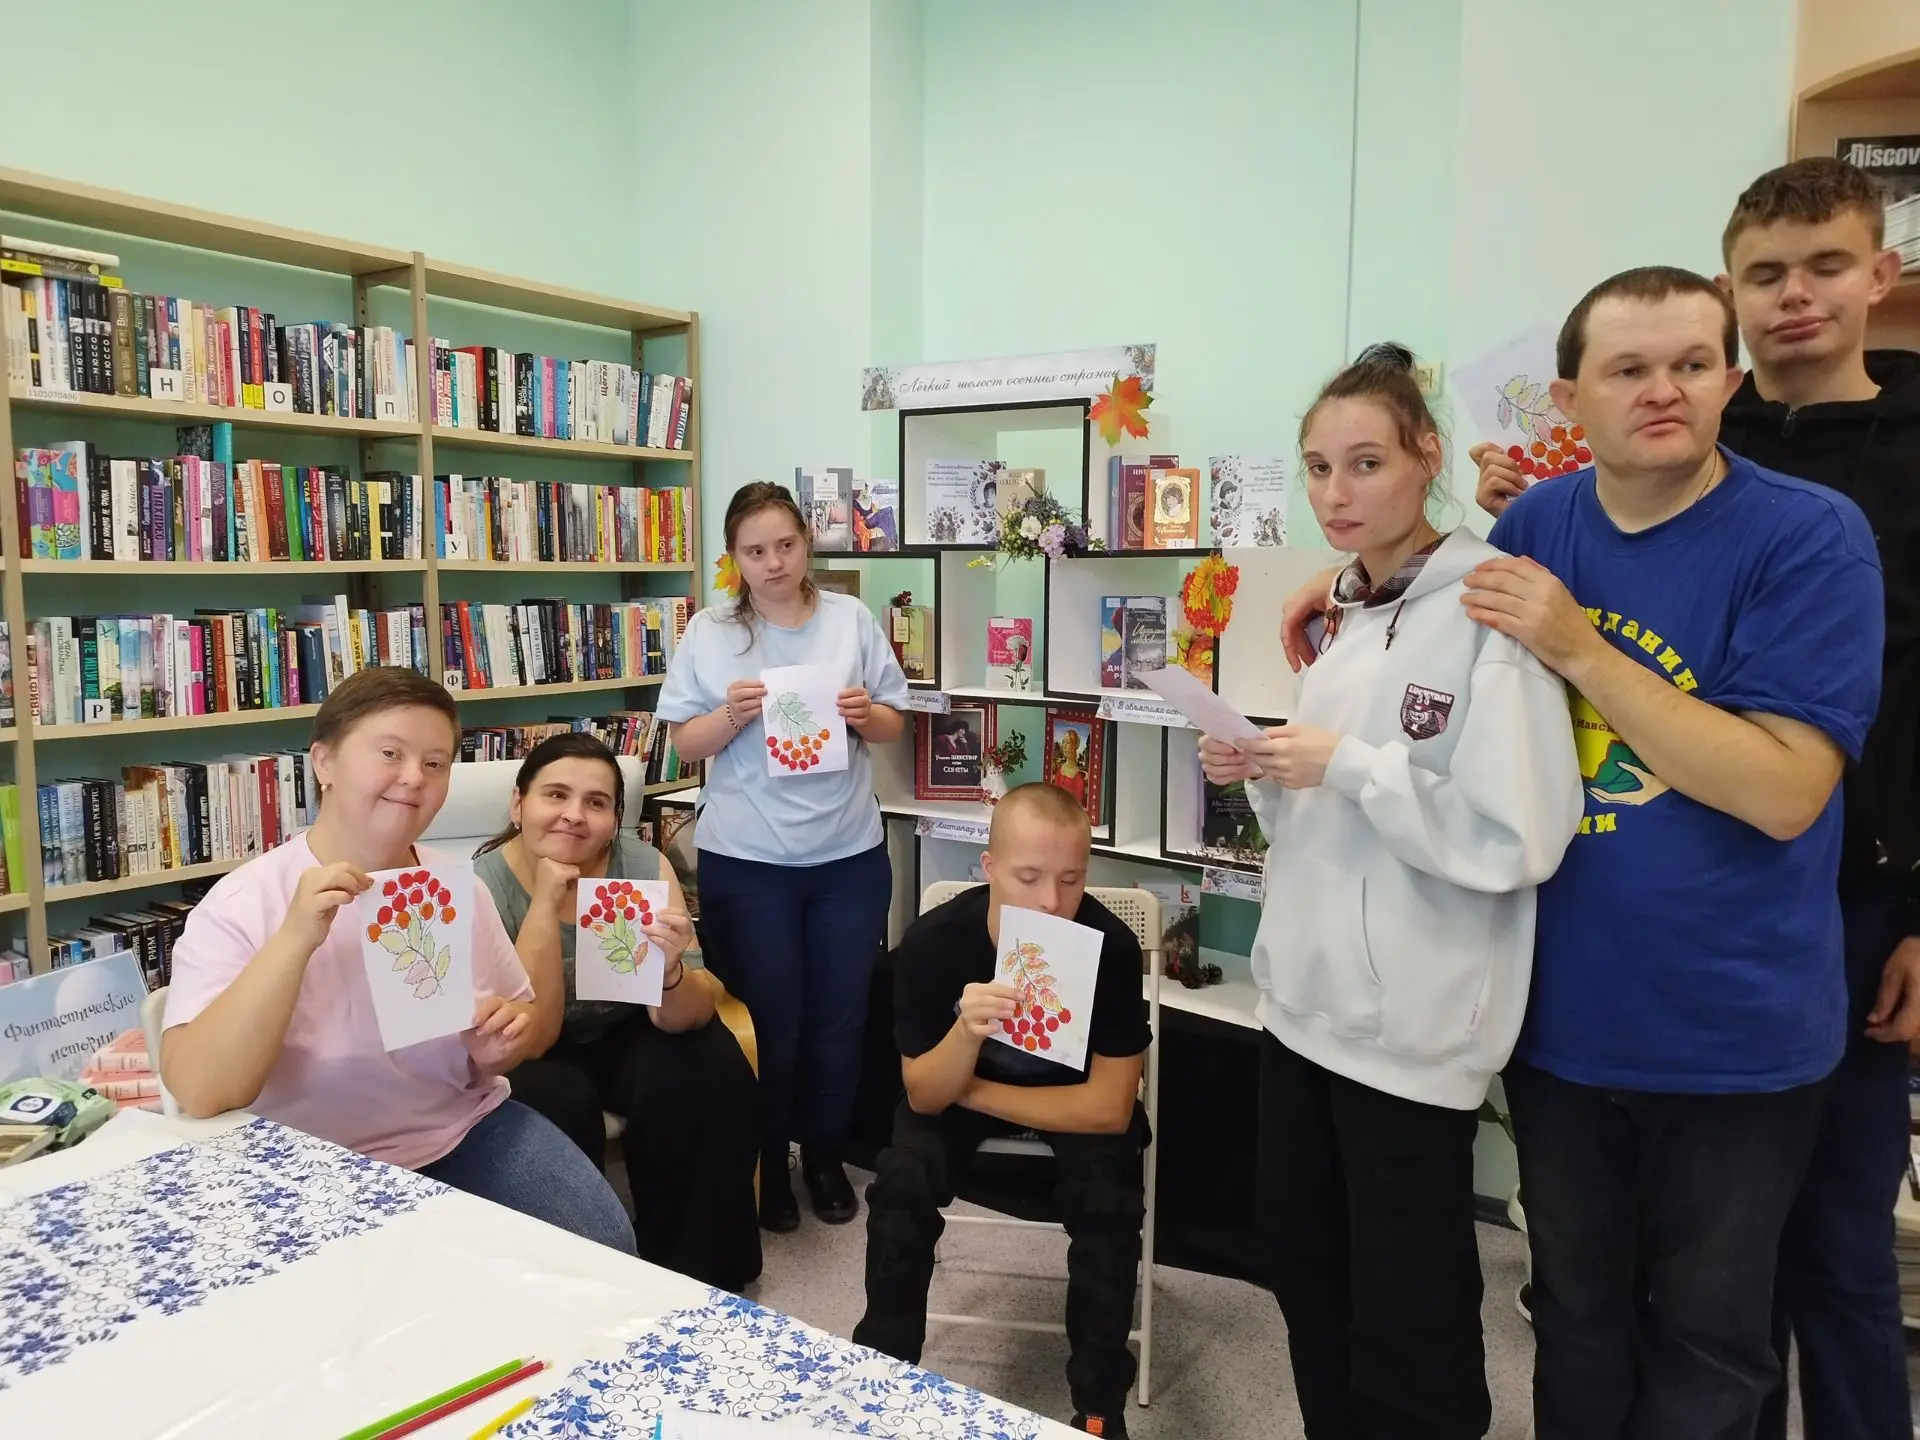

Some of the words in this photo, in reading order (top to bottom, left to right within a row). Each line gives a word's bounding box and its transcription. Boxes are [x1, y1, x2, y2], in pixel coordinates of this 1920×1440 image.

[600, 364, 609, 397] Щегол
[900, 377, 951, 393] Лёгкий
[957, 376, 1003, 389] шелест
[1006, 368, 1057, 387] осенних
[56, 624, 66, 676] ПРЕДЧУВСТВИЕ
[353, 641, 361, 661] БРАТ
[29, 674, 41, 717] СВИФТ
[93, 704, 104, 718] Р
[92, 788, 100, 820] РОБЕРТС
[936, 821, 977, 835] Листопад
[148, 936, 157, 961] РИМ
[4, 993, 136, 1043] Фантастические
[50, 1030, 117, 1064] истории
